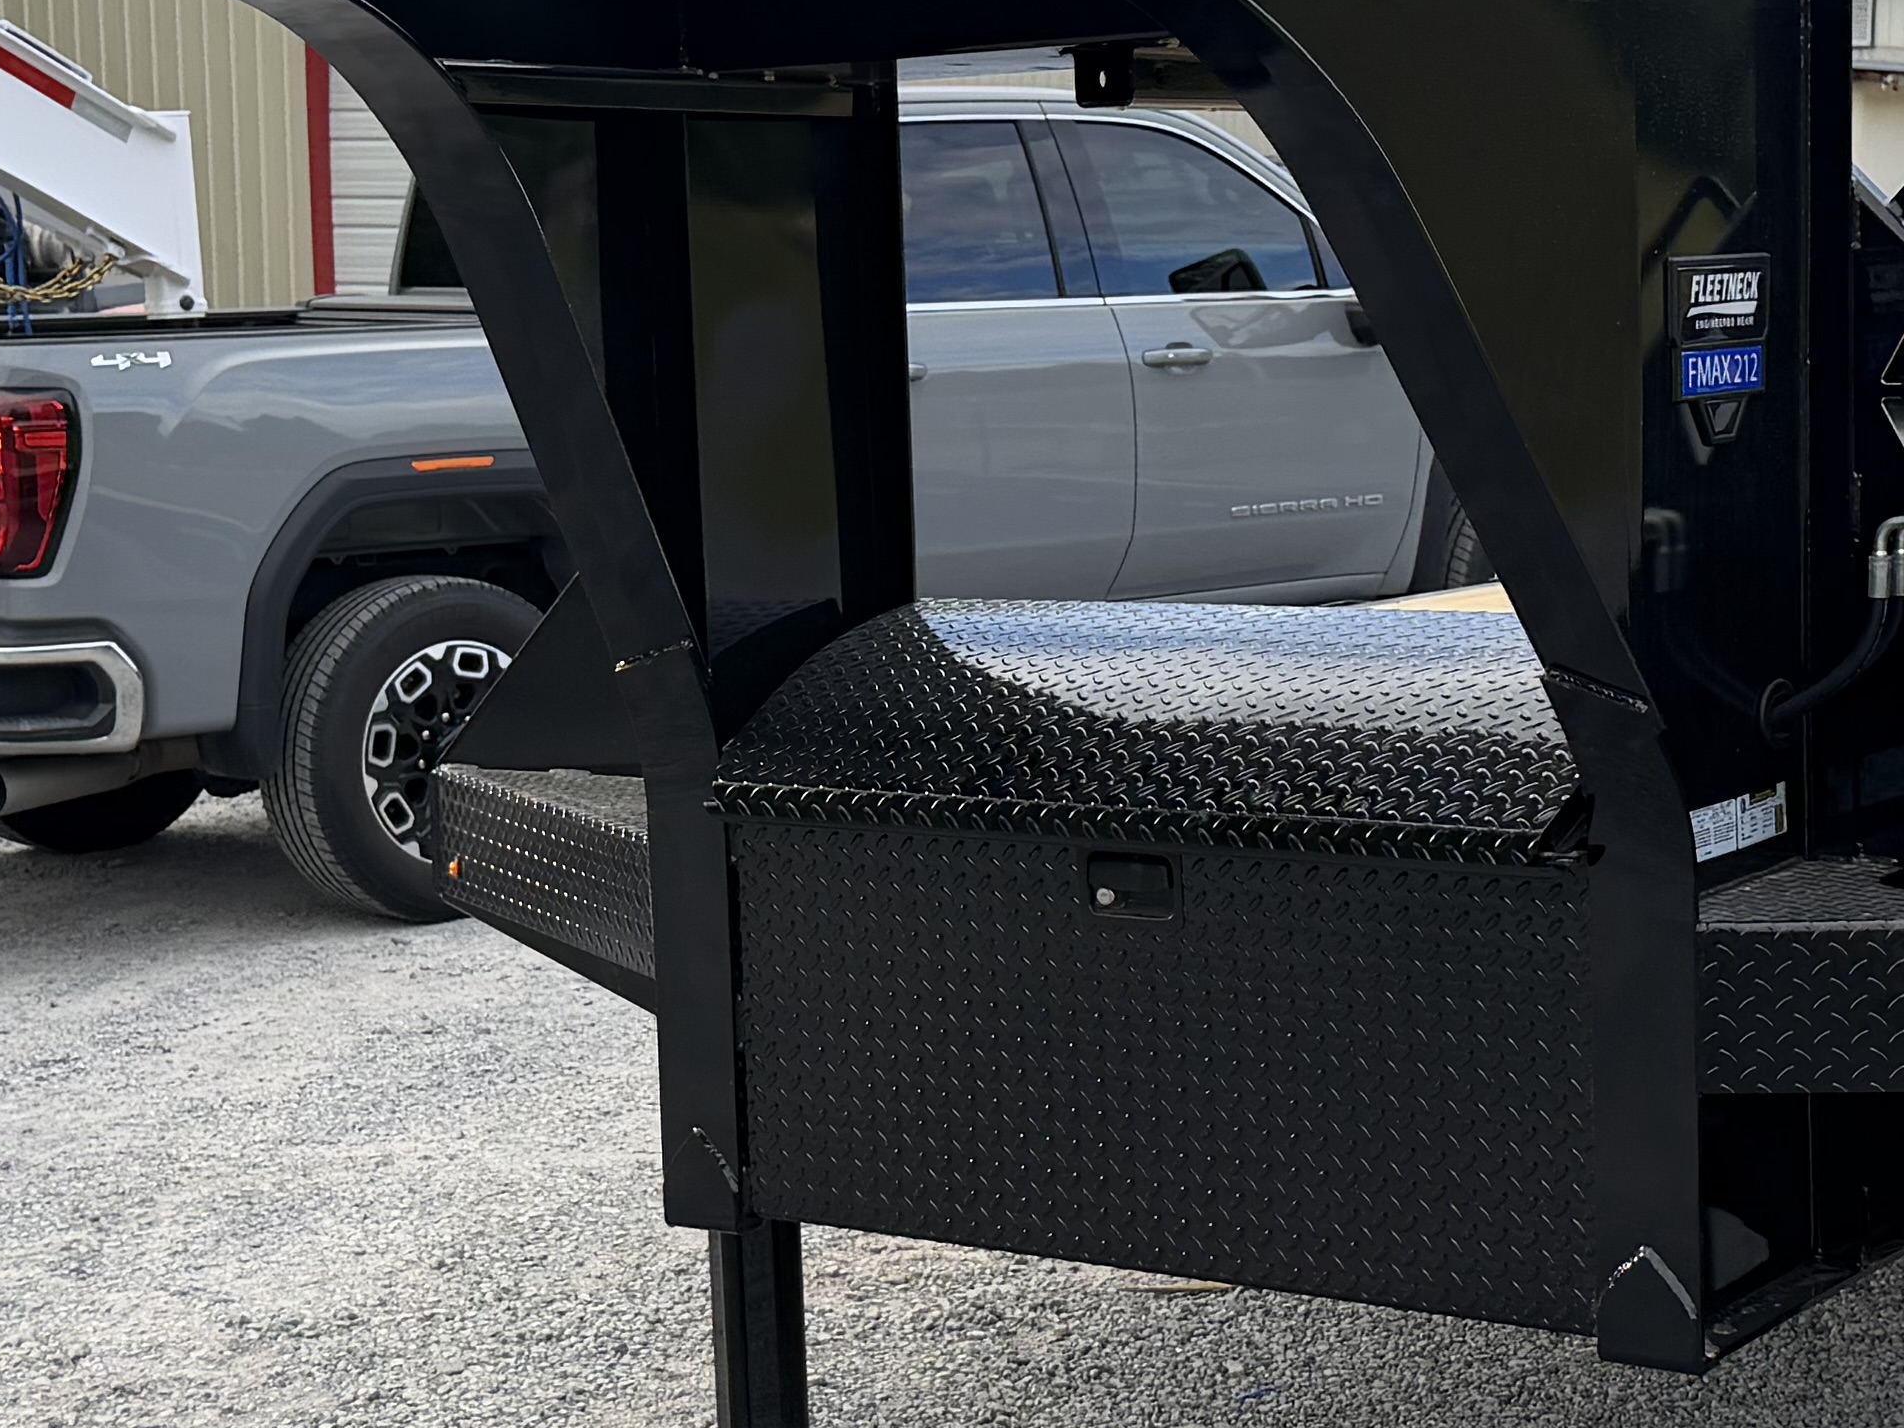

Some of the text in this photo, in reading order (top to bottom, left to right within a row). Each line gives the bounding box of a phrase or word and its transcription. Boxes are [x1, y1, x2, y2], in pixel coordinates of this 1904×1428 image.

[1690, 271, 1762, 304] FLEETNECK
[1688, 353, 1758, 388] FMAX 212
[1231, 493, 1384, 518] SIERRA HD
